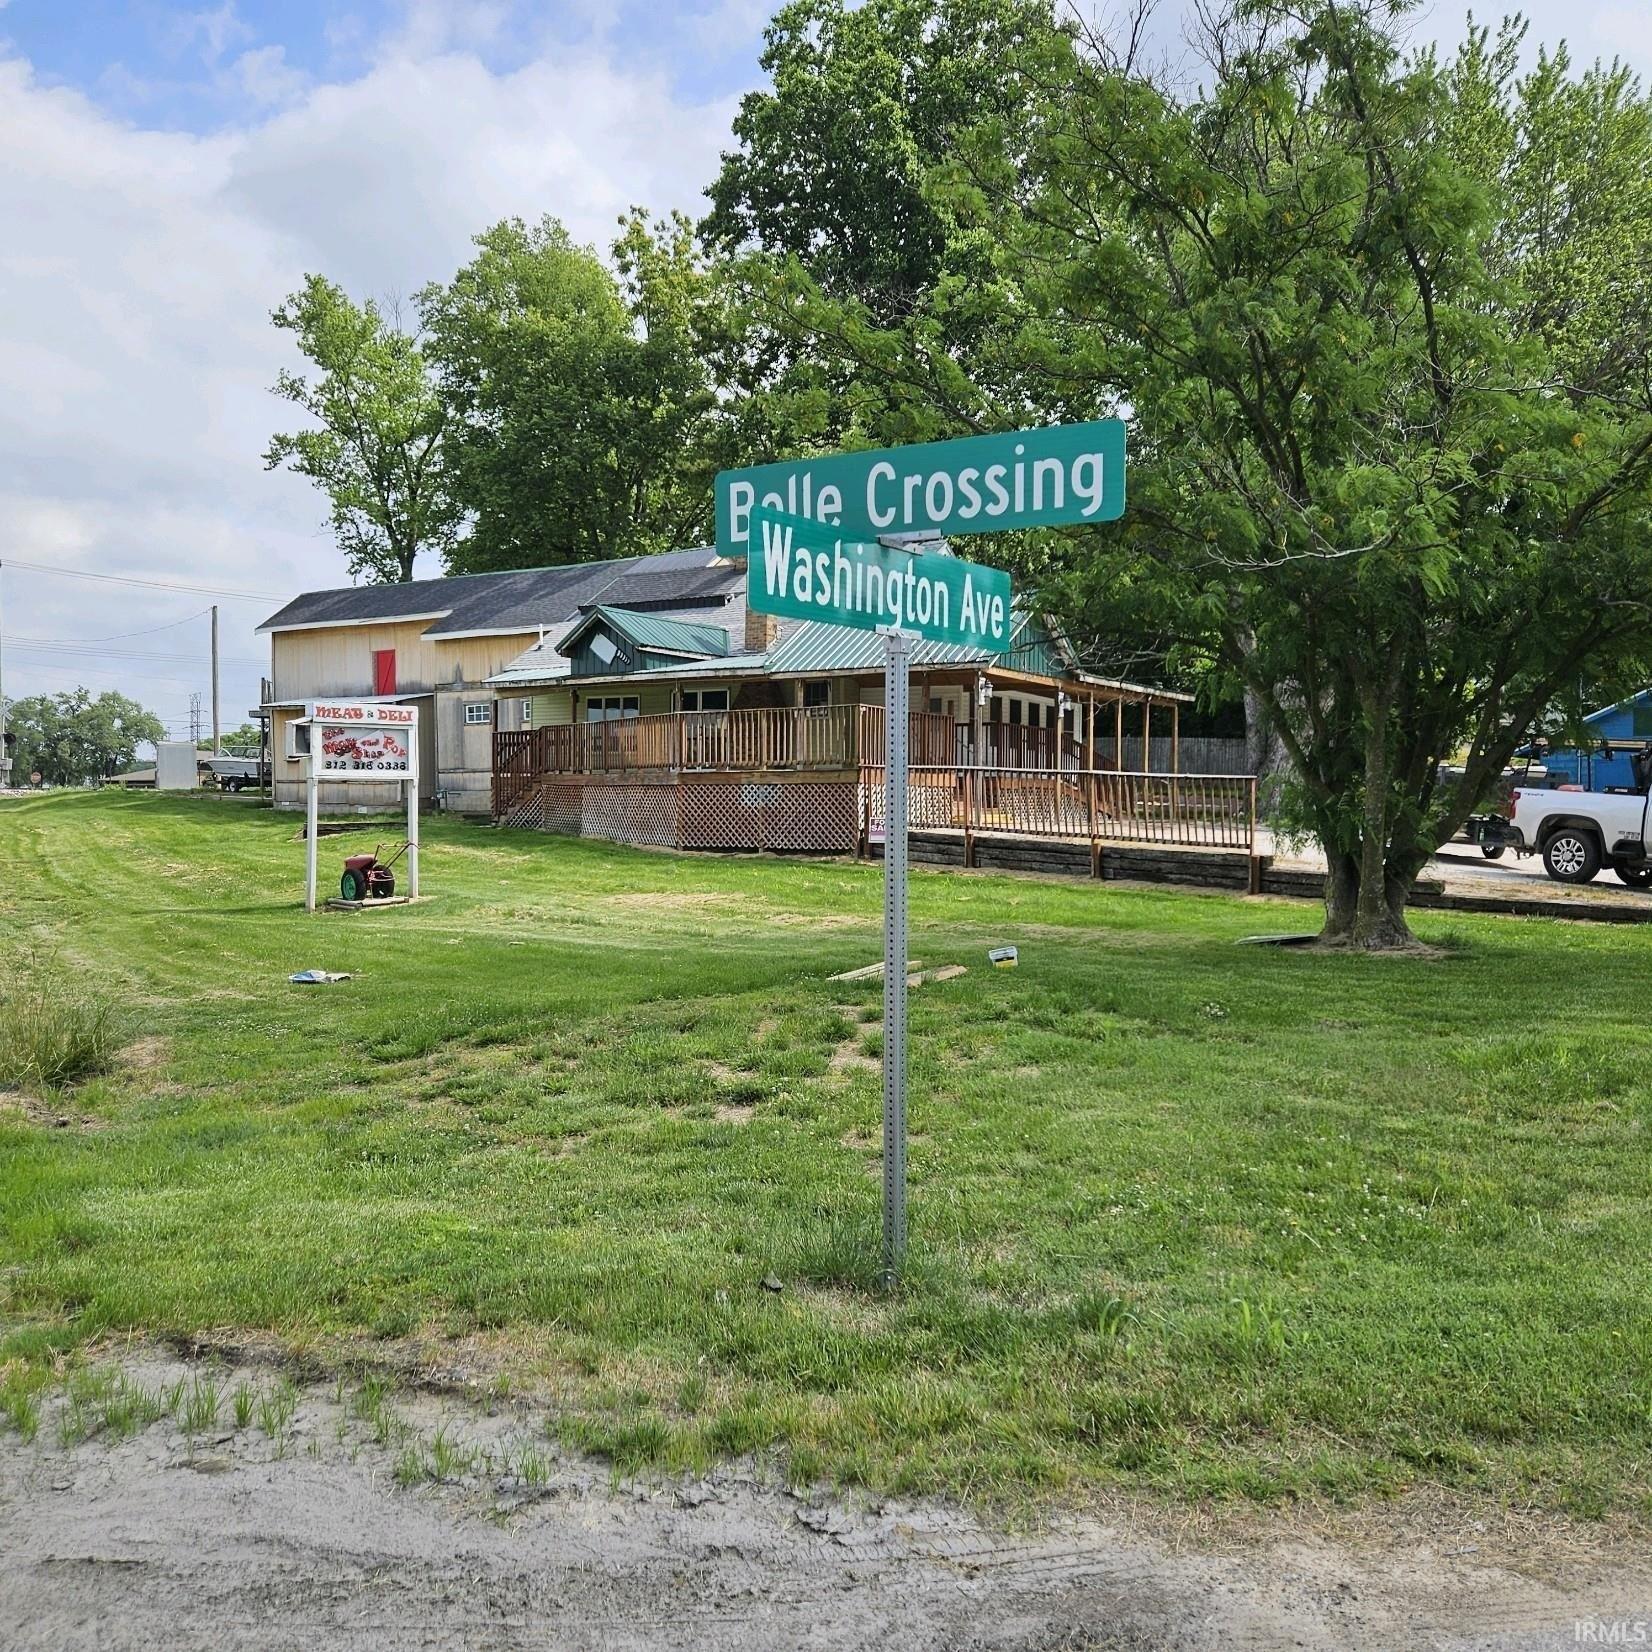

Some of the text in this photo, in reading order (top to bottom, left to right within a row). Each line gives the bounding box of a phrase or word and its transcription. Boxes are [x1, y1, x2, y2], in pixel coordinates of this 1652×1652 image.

[866, 443, 1104, 528] Crossing
[762, 520, 1004, 639] Washington Ave
[377, 709, 413, 722] DELI
[325, 760, 347, 770] 812
